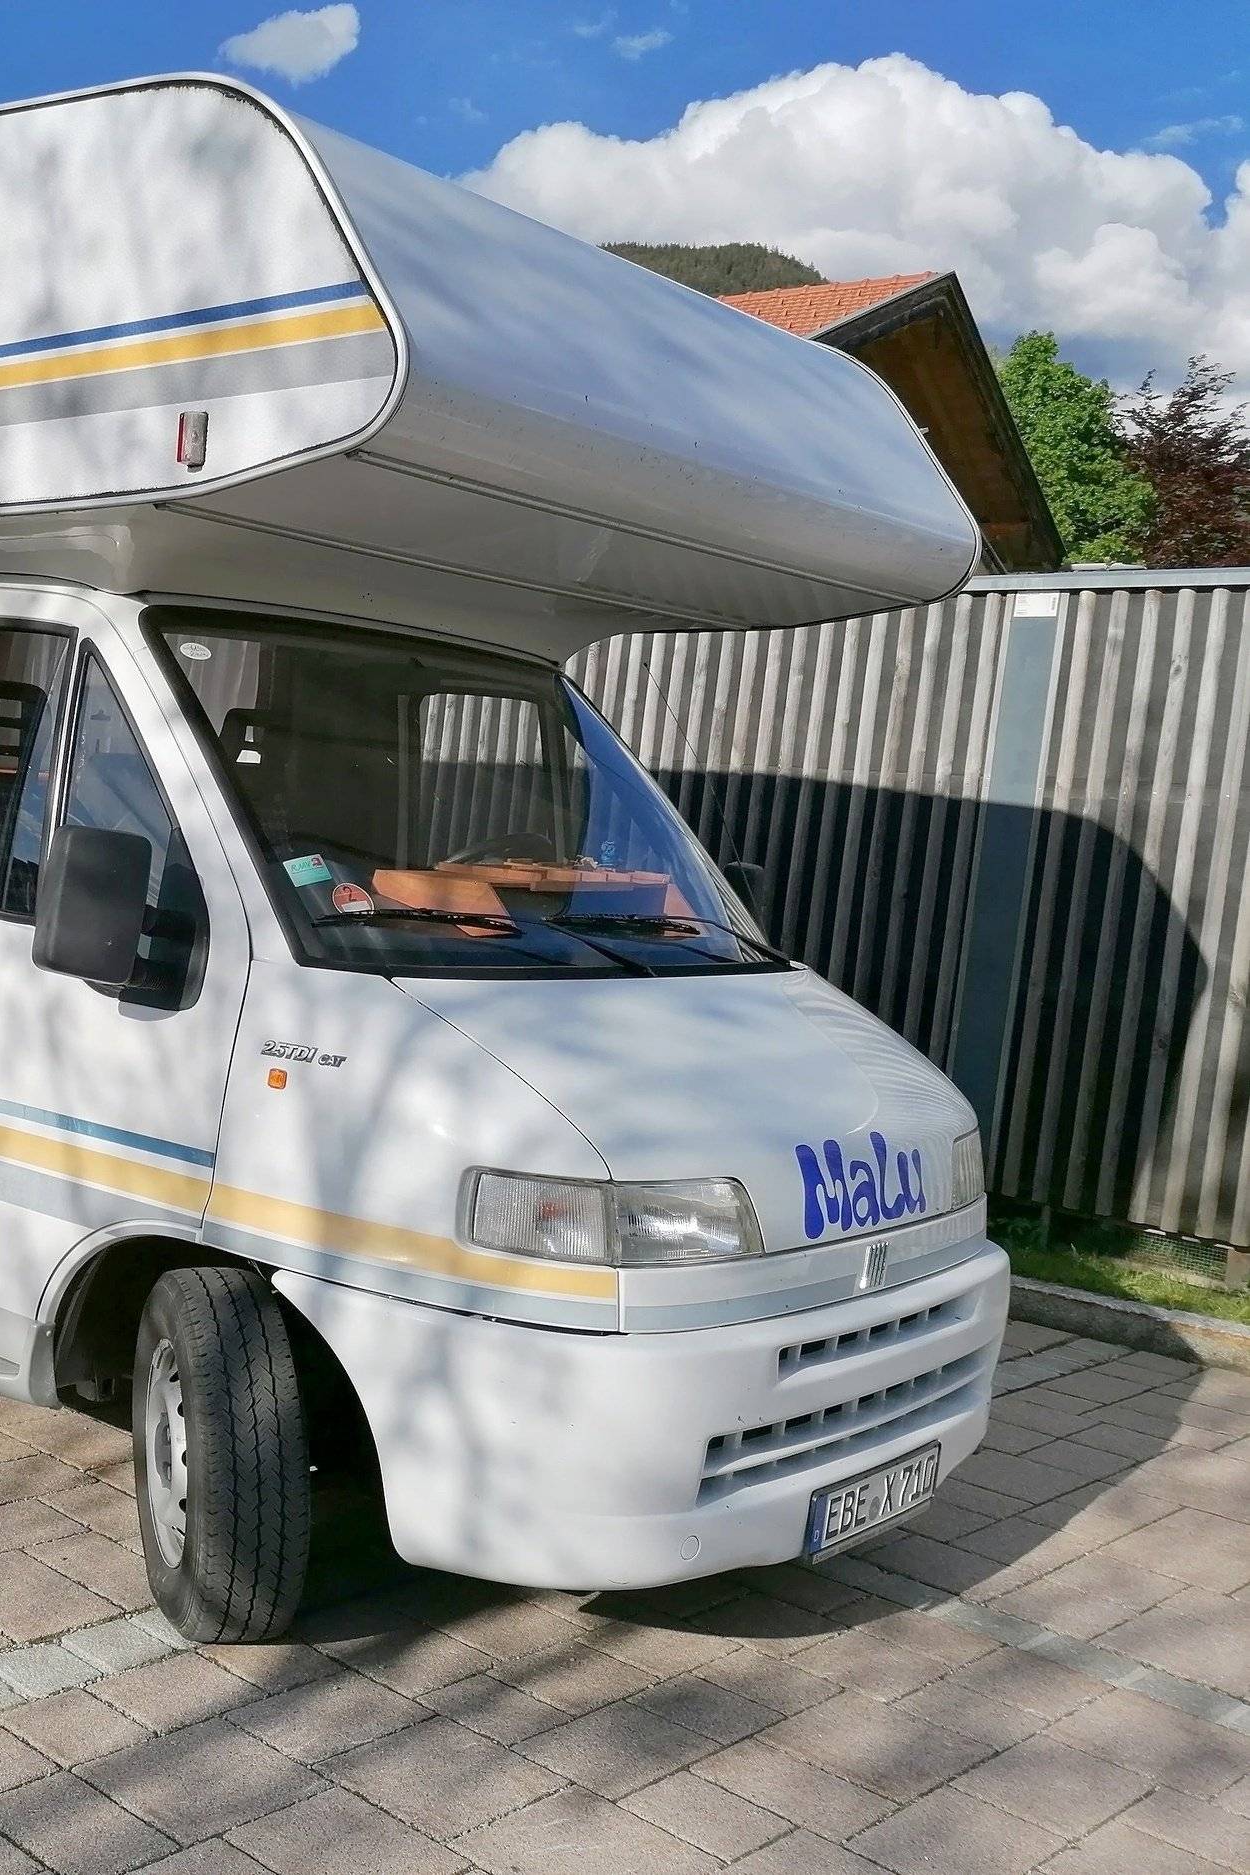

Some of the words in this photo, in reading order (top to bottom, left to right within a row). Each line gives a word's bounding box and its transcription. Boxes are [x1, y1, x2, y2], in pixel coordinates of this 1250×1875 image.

[823, 1483, 871, 1541] EBE
[878, 1471, 898, 1517] X
[899, 1454, 936, 1507] 710
